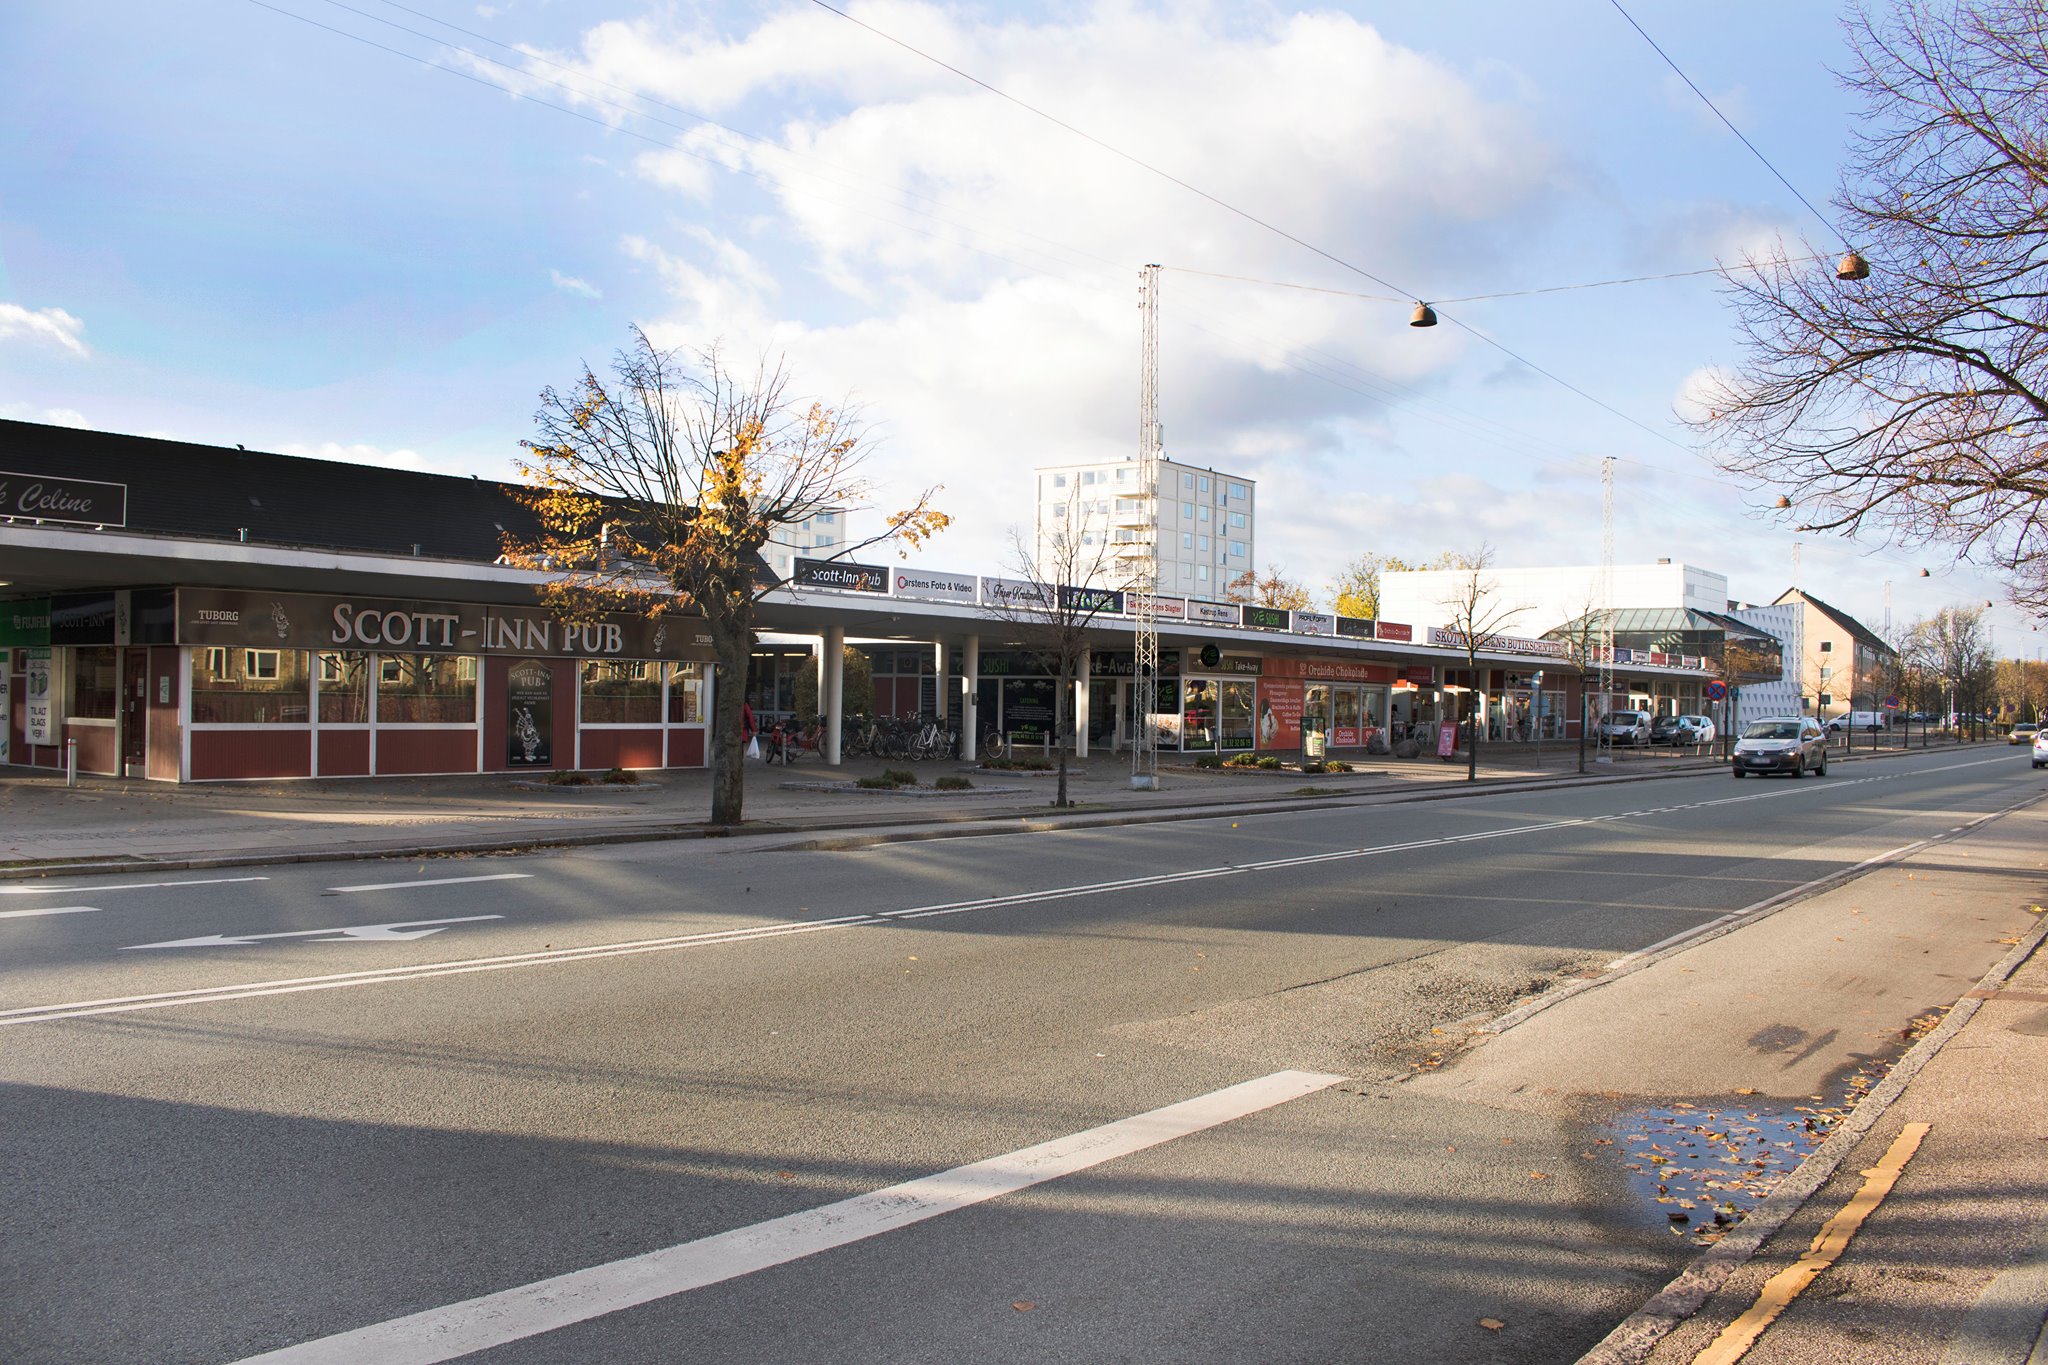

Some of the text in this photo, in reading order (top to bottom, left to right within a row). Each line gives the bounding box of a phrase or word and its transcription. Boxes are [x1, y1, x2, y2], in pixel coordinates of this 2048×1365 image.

[18, 484, 93, 513] Celine
[811, 568, 860, 586] Scott-Inn
[898, 576, 973, 594] Carstens Foto & Video
[198, 610, 239, 621] TUBORG
[1164, 605, 1182, 614] Slagter
[1200, 608, 1228, 618] Kastrup Rens
[331, 603, 624, 653] SCOTT-INN PUB
[695, 634, 714, 643] TUBO
[1507, 638, 1561, 654] BUTIKSCENTER
[983, 657, 1010, 673] SUSHI
[1089, 657, 1135, 674] ke-Awa
[1235, 661, 1259, 672] Take-Away
[1308, 664, 1368, 679] Orchide Chokolade
[511, 668, 551, 681] SCOTT-INN
[31, 718, 46, 727] SLAGS
